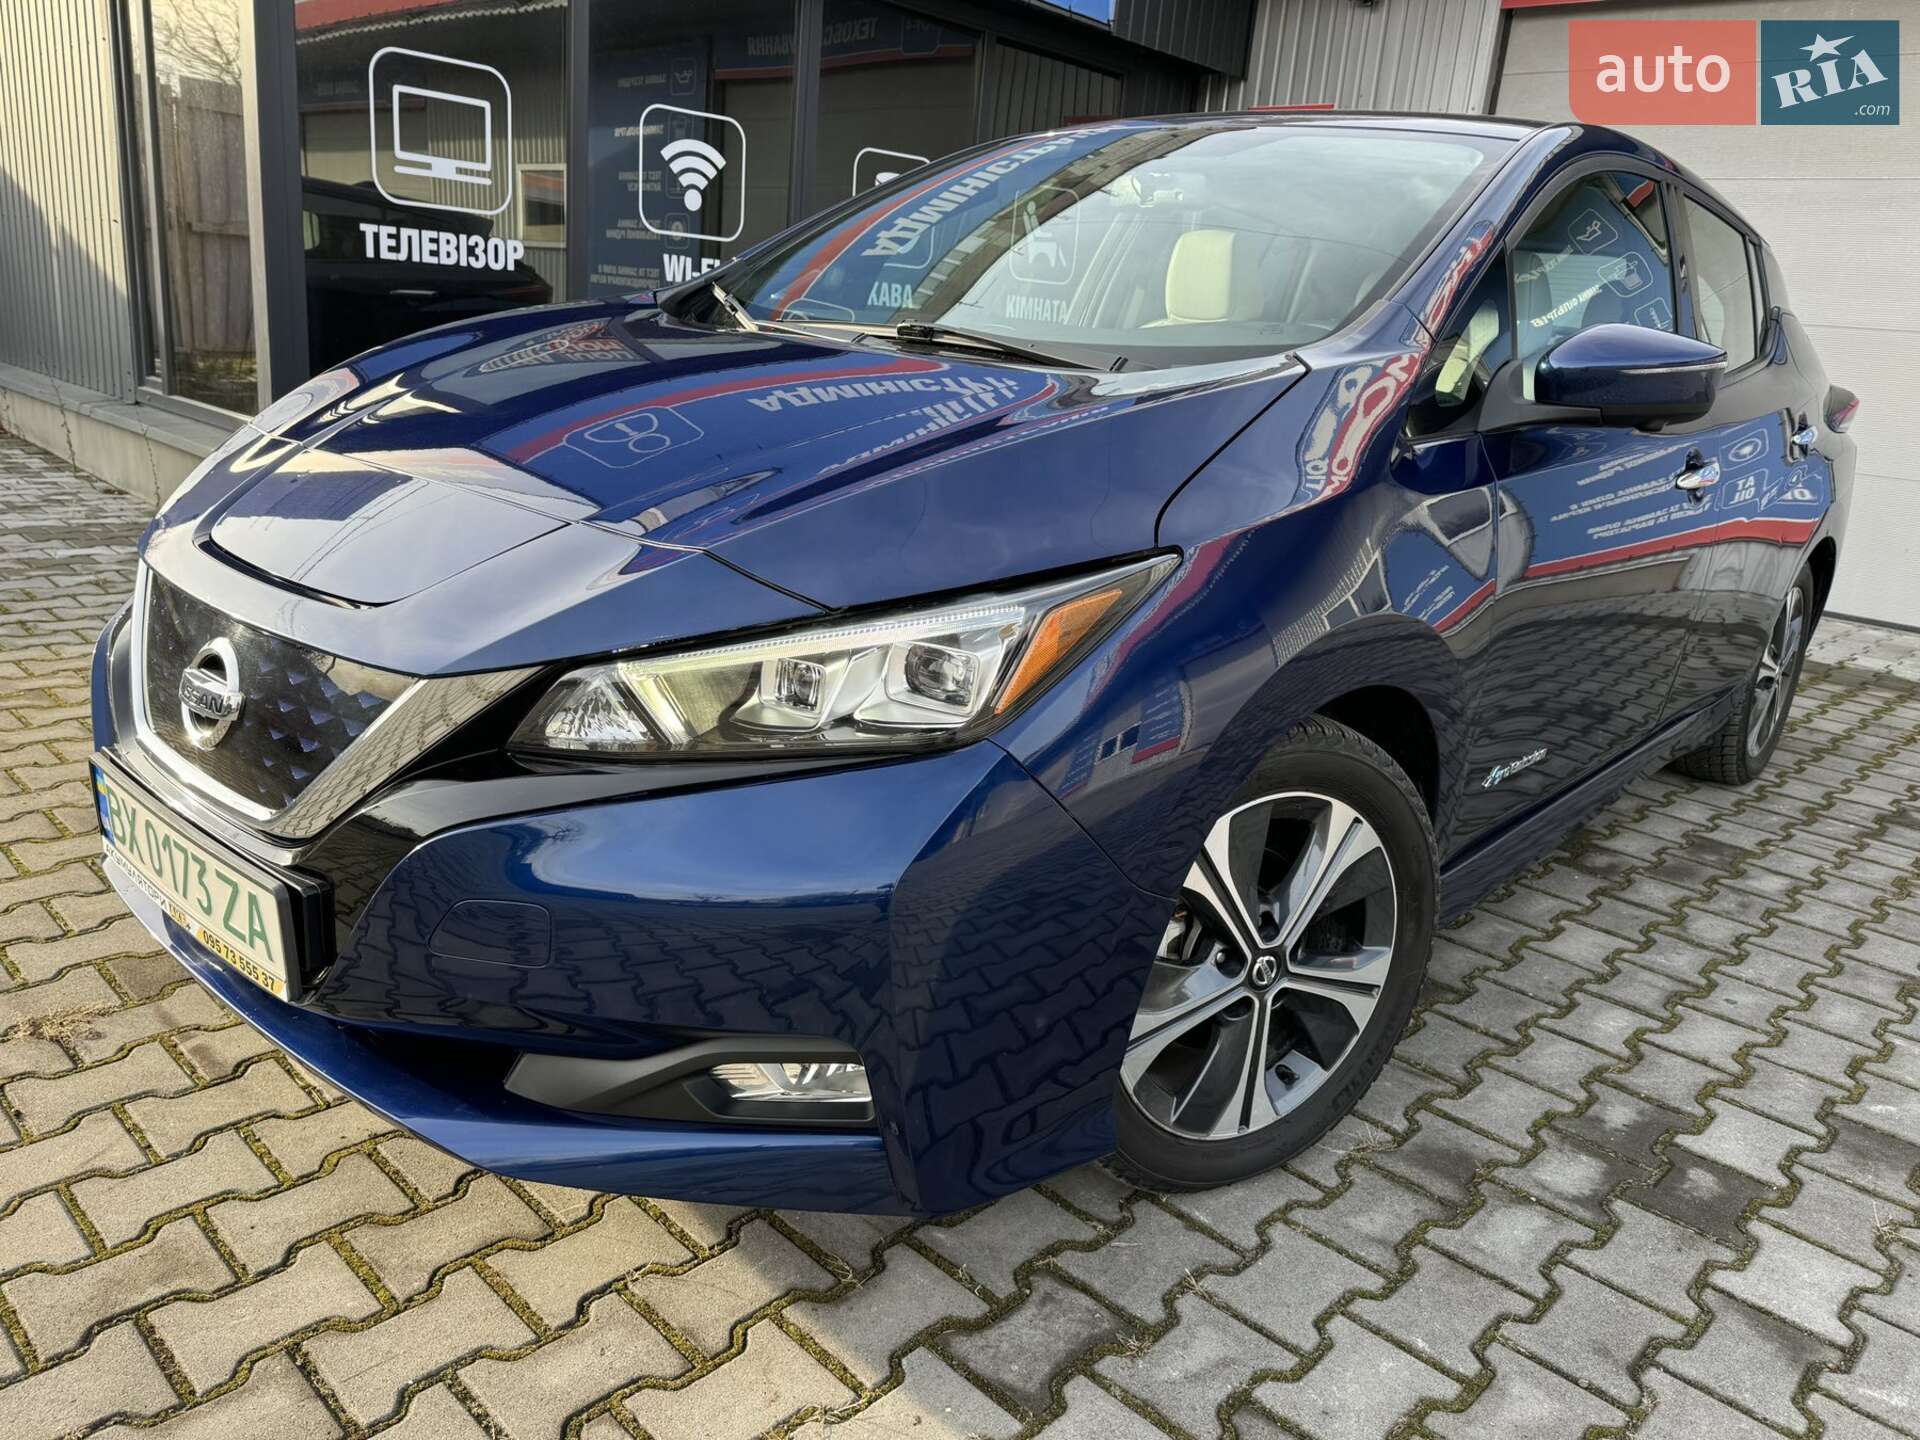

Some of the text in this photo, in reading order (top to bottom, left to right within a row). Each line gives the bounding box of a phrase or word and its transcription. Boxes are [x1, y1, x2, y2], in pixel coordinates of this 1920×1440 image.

[359, 222, 525, 272] ТЕЛЕВІЗОР
[1005, 295, 1070, 325] КІМНАТА
[106, 785, 275, 963] BX 0173 ZA
[203, 930, 275, 992] 095 73 555 37
